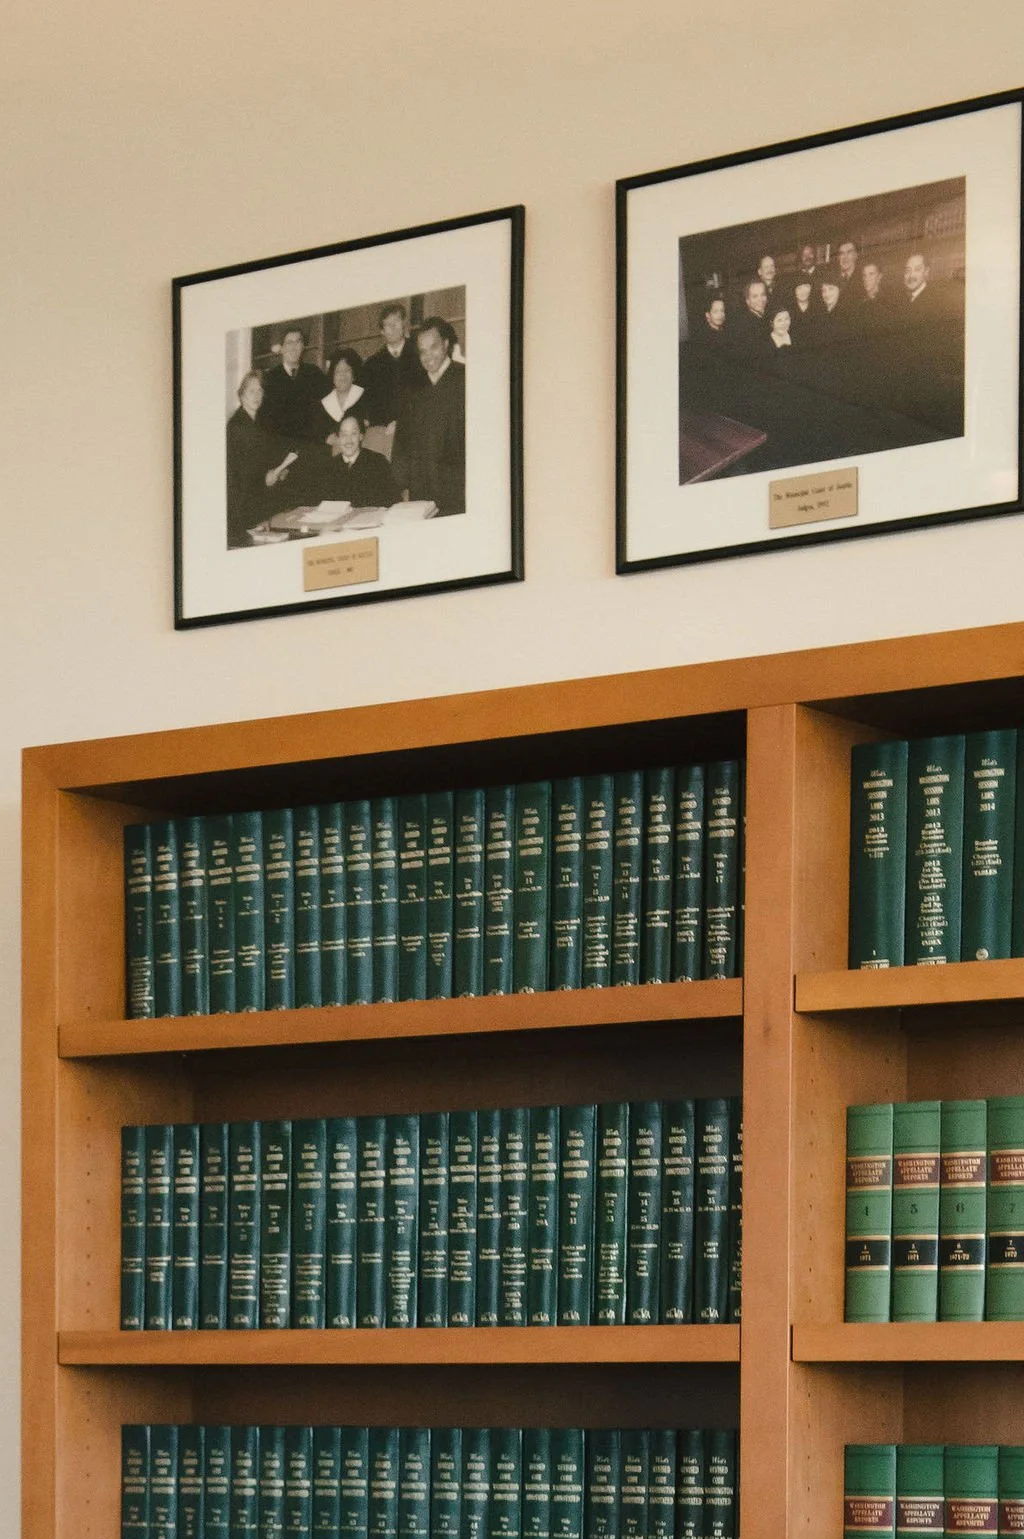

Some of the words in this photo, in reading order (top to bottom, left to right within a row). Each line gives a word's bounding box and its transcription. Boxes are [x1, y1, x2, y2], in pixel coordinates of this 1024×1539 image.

[979, 802, 995, 812] 2014
[898, 1159, 936, 1167] WASHINGTON
[944, 1158, 981, 1166] WASHINGTON
[996, 1156, 1024, 1164] WASHING
[945, 1165, 977, 1173] APPELLATE
[998, 1163, 1024, 1171] APPELLA
[948, 1172, 973, 1180] REPORTS
[910, 1204, 918, 1214] 5
[955, 1202, 965, 1213] 6
[953, 1512, 989, 1520] APPELLATE
